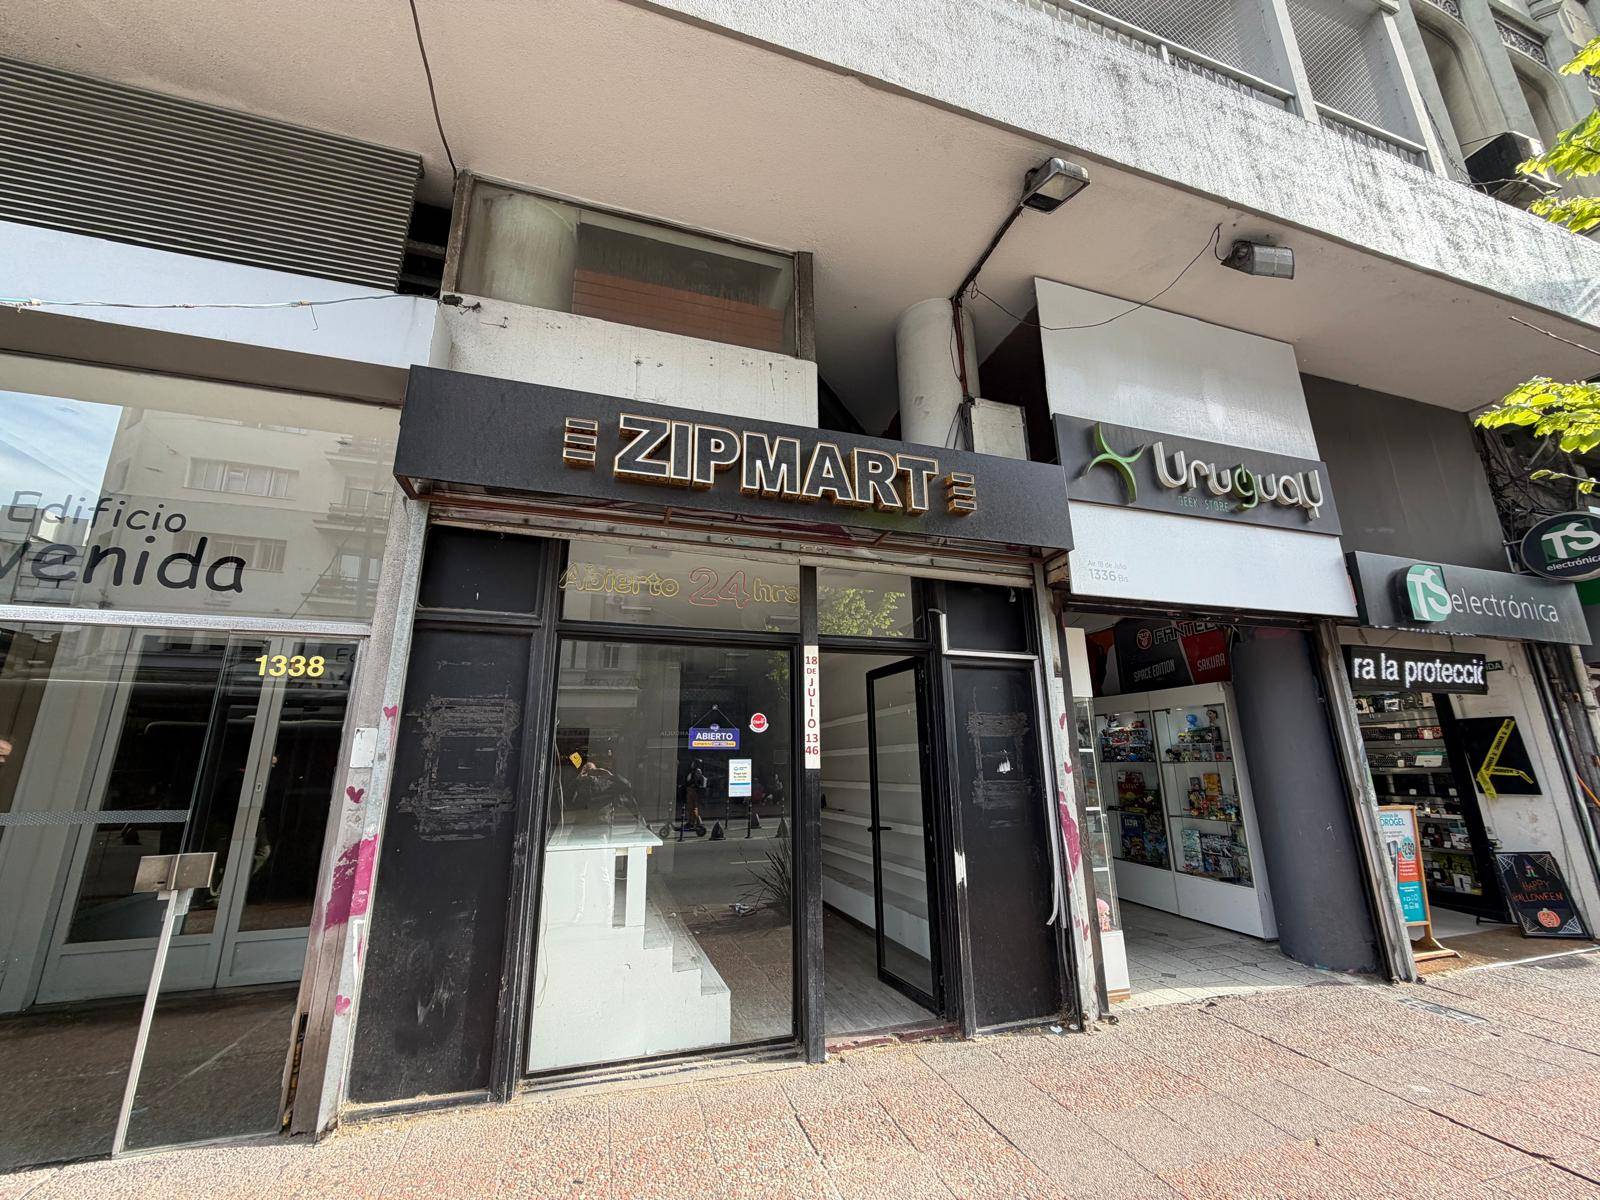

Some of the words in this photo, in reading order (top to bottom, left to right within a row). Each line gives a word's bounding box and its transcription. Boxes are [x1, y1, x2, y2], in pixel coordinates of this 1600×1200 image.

[613, 413, 939, 514] ZIPMART
[1152, 441, 1324, 521] Uruguay
[7, 490, 187, 534] Edificio
[1178, 495, 1199, 508] GEEK
[1204, 499, 1230, 513] STORE
[1541, 522, 1600, 559] TS
[558, 561, 680, 598] Abierto
[688, 567, 751, 609] 24
[753, 577, 801, 604] hrs
[1088, 568, 1117, 582] 1336
[1407, 567, 1453, 620] TS
[1451, 587, 1560, 624] electrónica
[255, 654, 325, 678] 1338
[805, 655, 818, 665] 18
[806, 667, 817, 675] DE
[1133, 666, 1153, 683] SPACE
[1152, 658, 1176, 677] EDITION
[1196, 652, 1226, 672] SAKURA
[1353, 657, 1376, 680] ra
[1380, 653, 1400, 681] la
[807, 677, 817, 730] JULIO
[695, 732, 733, 741] ABIERTO
